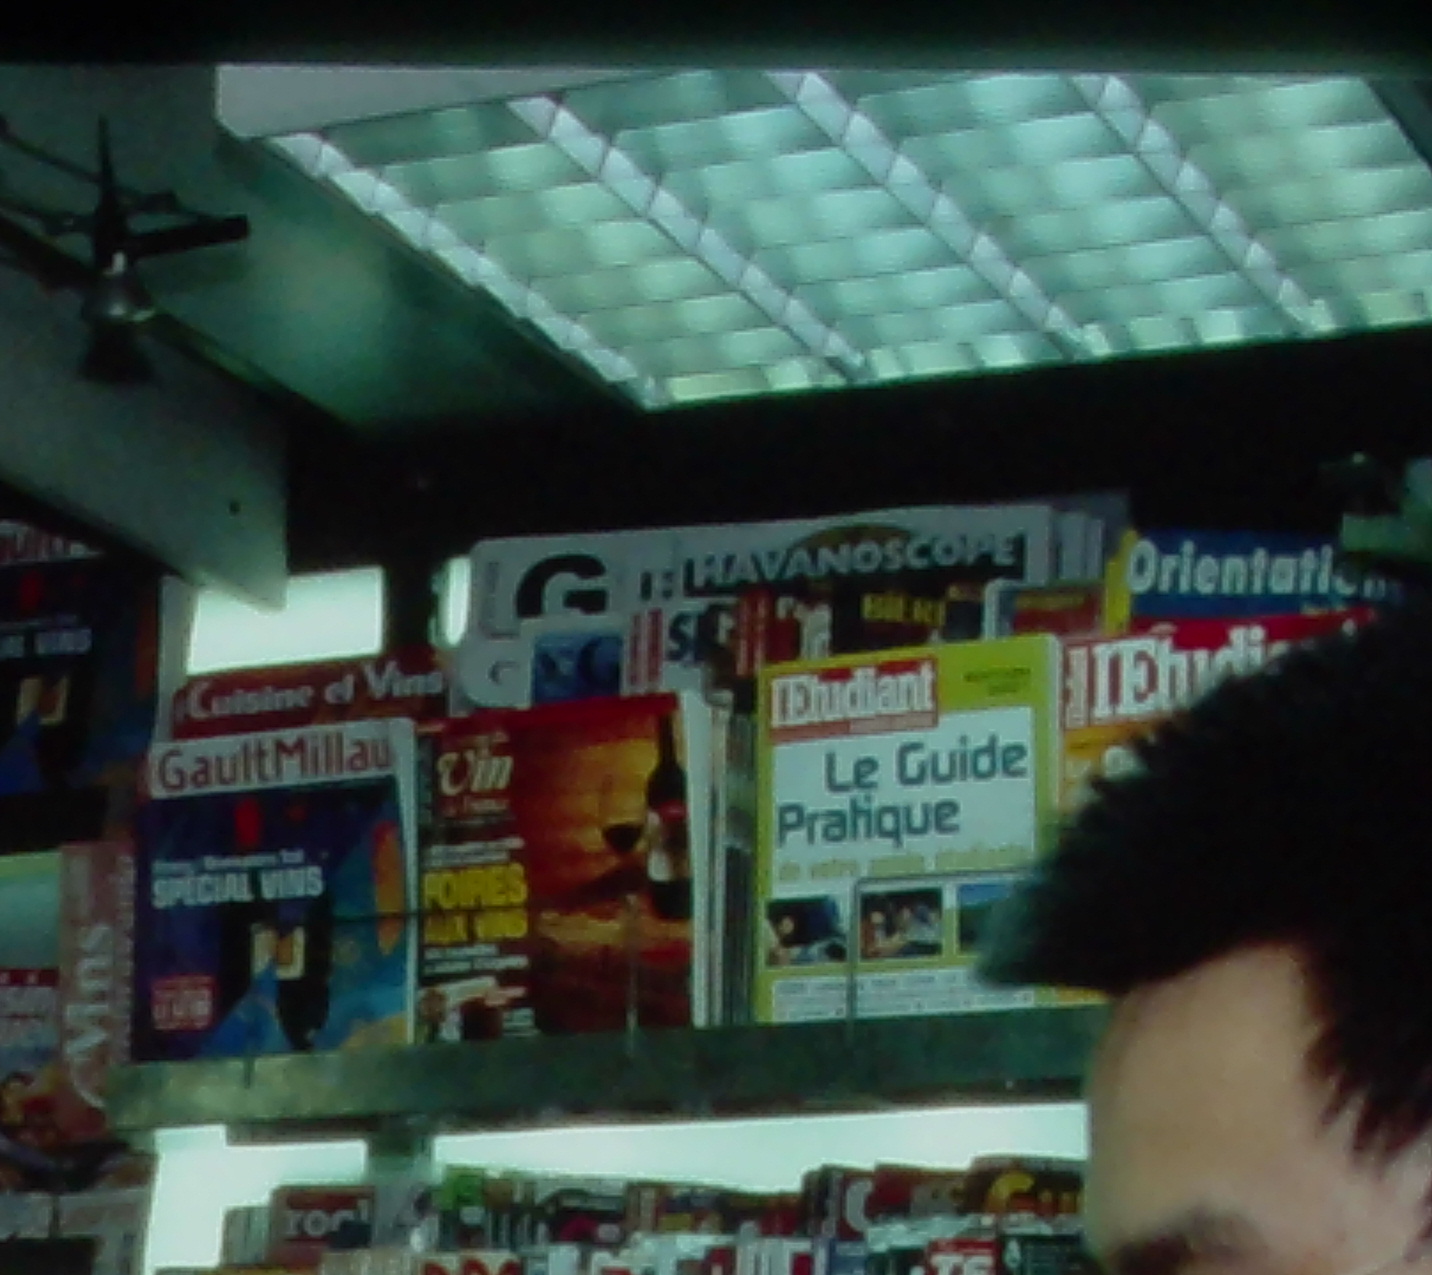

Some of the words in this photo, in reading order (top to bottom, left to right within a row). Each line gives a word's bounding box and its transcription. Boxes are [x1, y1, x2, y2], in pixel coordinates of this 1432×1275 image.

[158, 733, 393, 793] GaultMillau
[437, 748, 514, 795] Vin
[825, 751, 879, 792] Le
[897, 734, 1027, 786] Guide
[777, 796, 960, 849] Pratique
